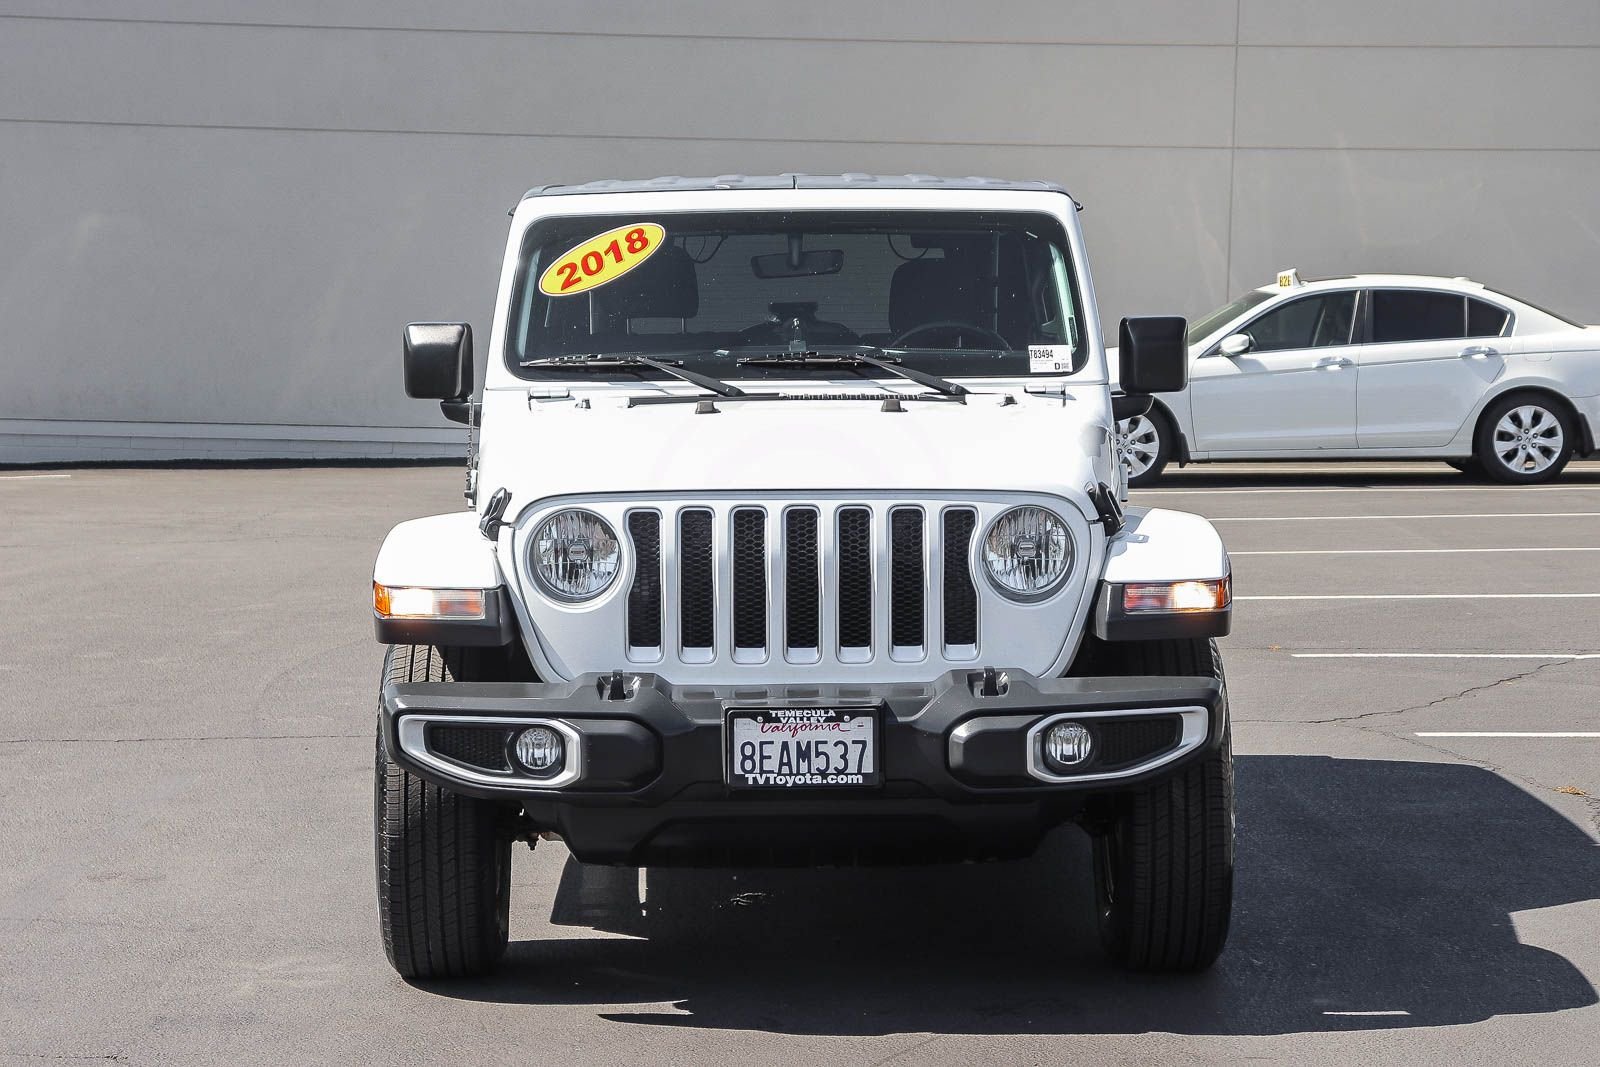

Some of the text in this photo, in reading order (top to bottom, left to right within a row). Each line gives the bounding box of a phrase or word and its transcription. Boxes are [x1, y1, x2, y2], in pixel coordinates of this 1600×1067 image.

[557, 228, 649, 291] 2018
[1030, 349, 1054, 359] T83494
[769, 709, 836, 717] TEMECULA
[760, 722, 851, 738] California
[740, 740, 867, 774] 8EAM537
[745, 774, 863, 787] TVToyota.com
